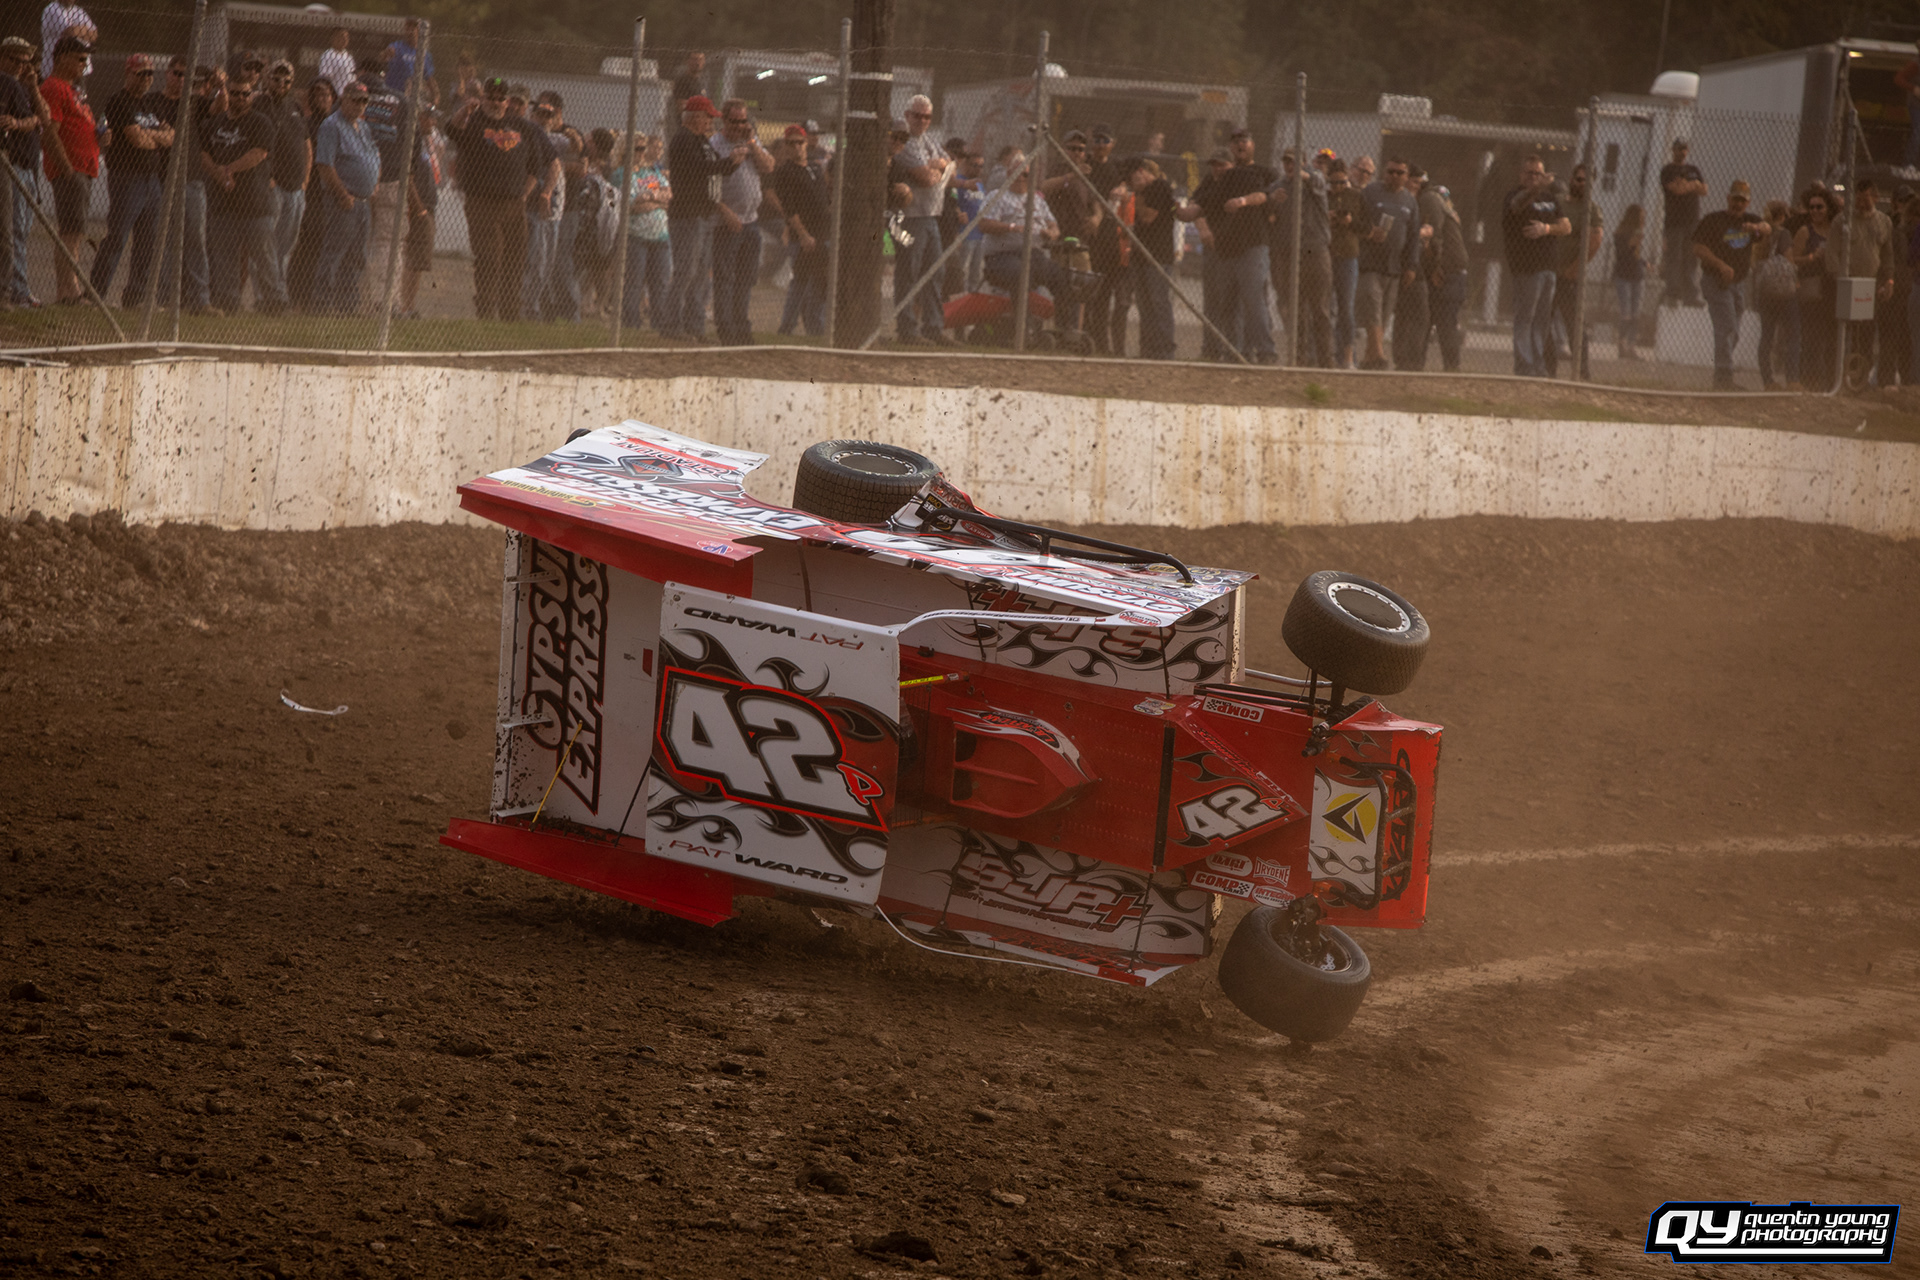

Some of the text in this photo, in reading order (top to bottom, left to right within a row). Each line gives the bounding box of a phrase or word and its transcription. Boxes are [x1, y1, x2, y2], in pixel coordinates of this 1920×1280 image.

[602, 476, 824, 531] EXPRESS
[1027, 575, 1189, 614] GYPSUM
[522, 540, 571, 749] GYPSU
[684, 606, 865, 651] PAT WARD
[1210, 698, 1232, 707] CAMS
[1216, 703, 1261, 721] COMP
[668, 839, 849, 885] PAT WARD
[1254, 859, 1290, 884] DRYDENE
[1195, 872, 1240, 890] COMP
[1222, 887, 1245, 896] CAMS
